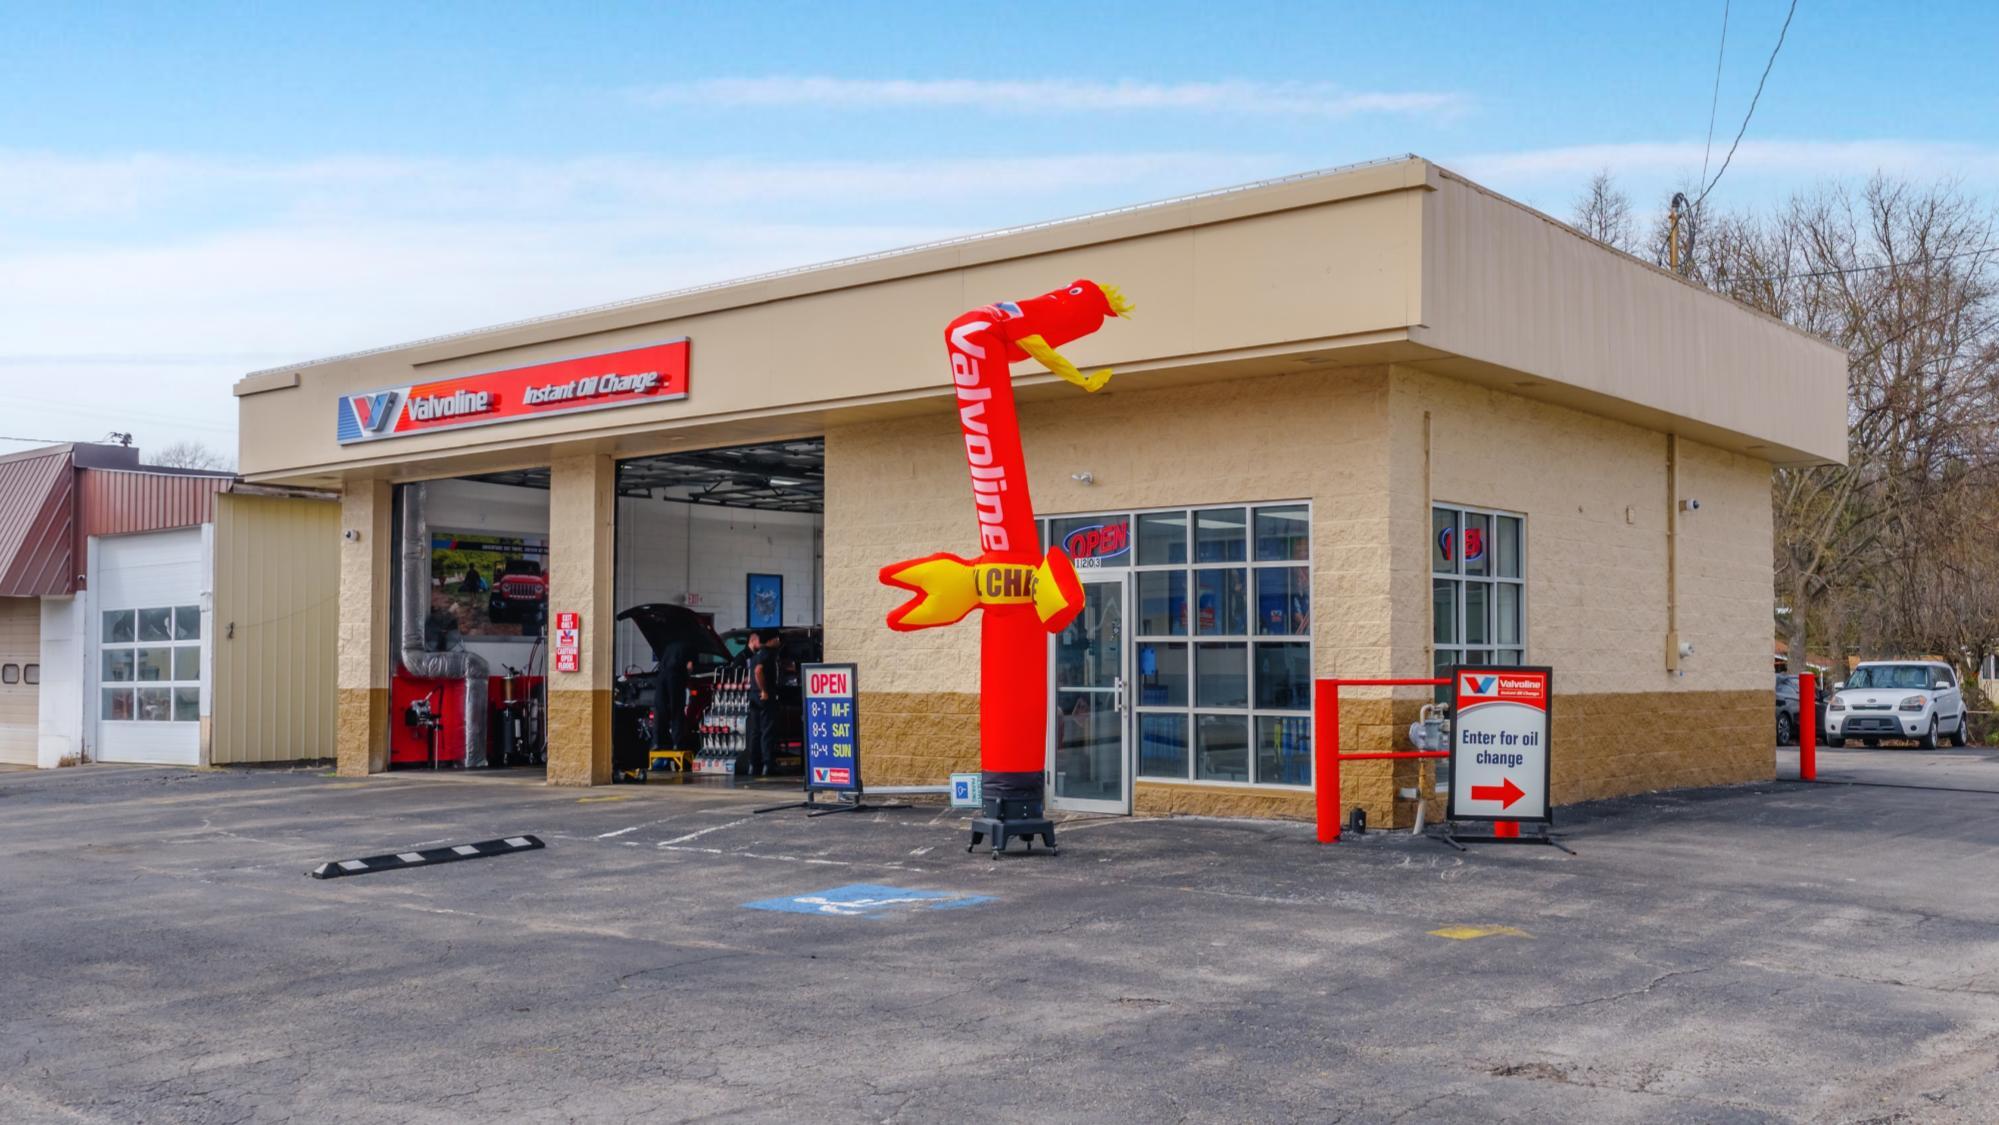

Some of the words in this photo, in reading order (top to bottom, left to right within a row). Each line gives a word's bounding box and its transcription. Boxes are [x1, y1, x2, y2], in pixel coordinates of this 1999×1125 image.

[522, 381, 576, 404] Instant
[577, 375, 598, 396] Oil
[598, 371, 658, 394] Change
[408, 389, 489, 421] Valvoline
[949, 320, 1011, 552] Valvoline
[1069, 518, 1127, 559] OPEN
[1076, 559, 1101, 568] 1203
[810, 673, 847, 695] OPEN
[1500, 680, 1541, 689] Valvoline
[811, 702, 827, 716] 8-7
[832, 703, 850, 716] M-F
[812, 722, 828, 737] 8-5
[832, 723, 850, 737] SAT
[1462, 730, 1497, 745] Enter
[1500, 730, 1519, 746] for
[1522, 731, 1539, 746] oil
[833, 743, 851, 757] SUN
[1476, 750, 1524, 769] change
